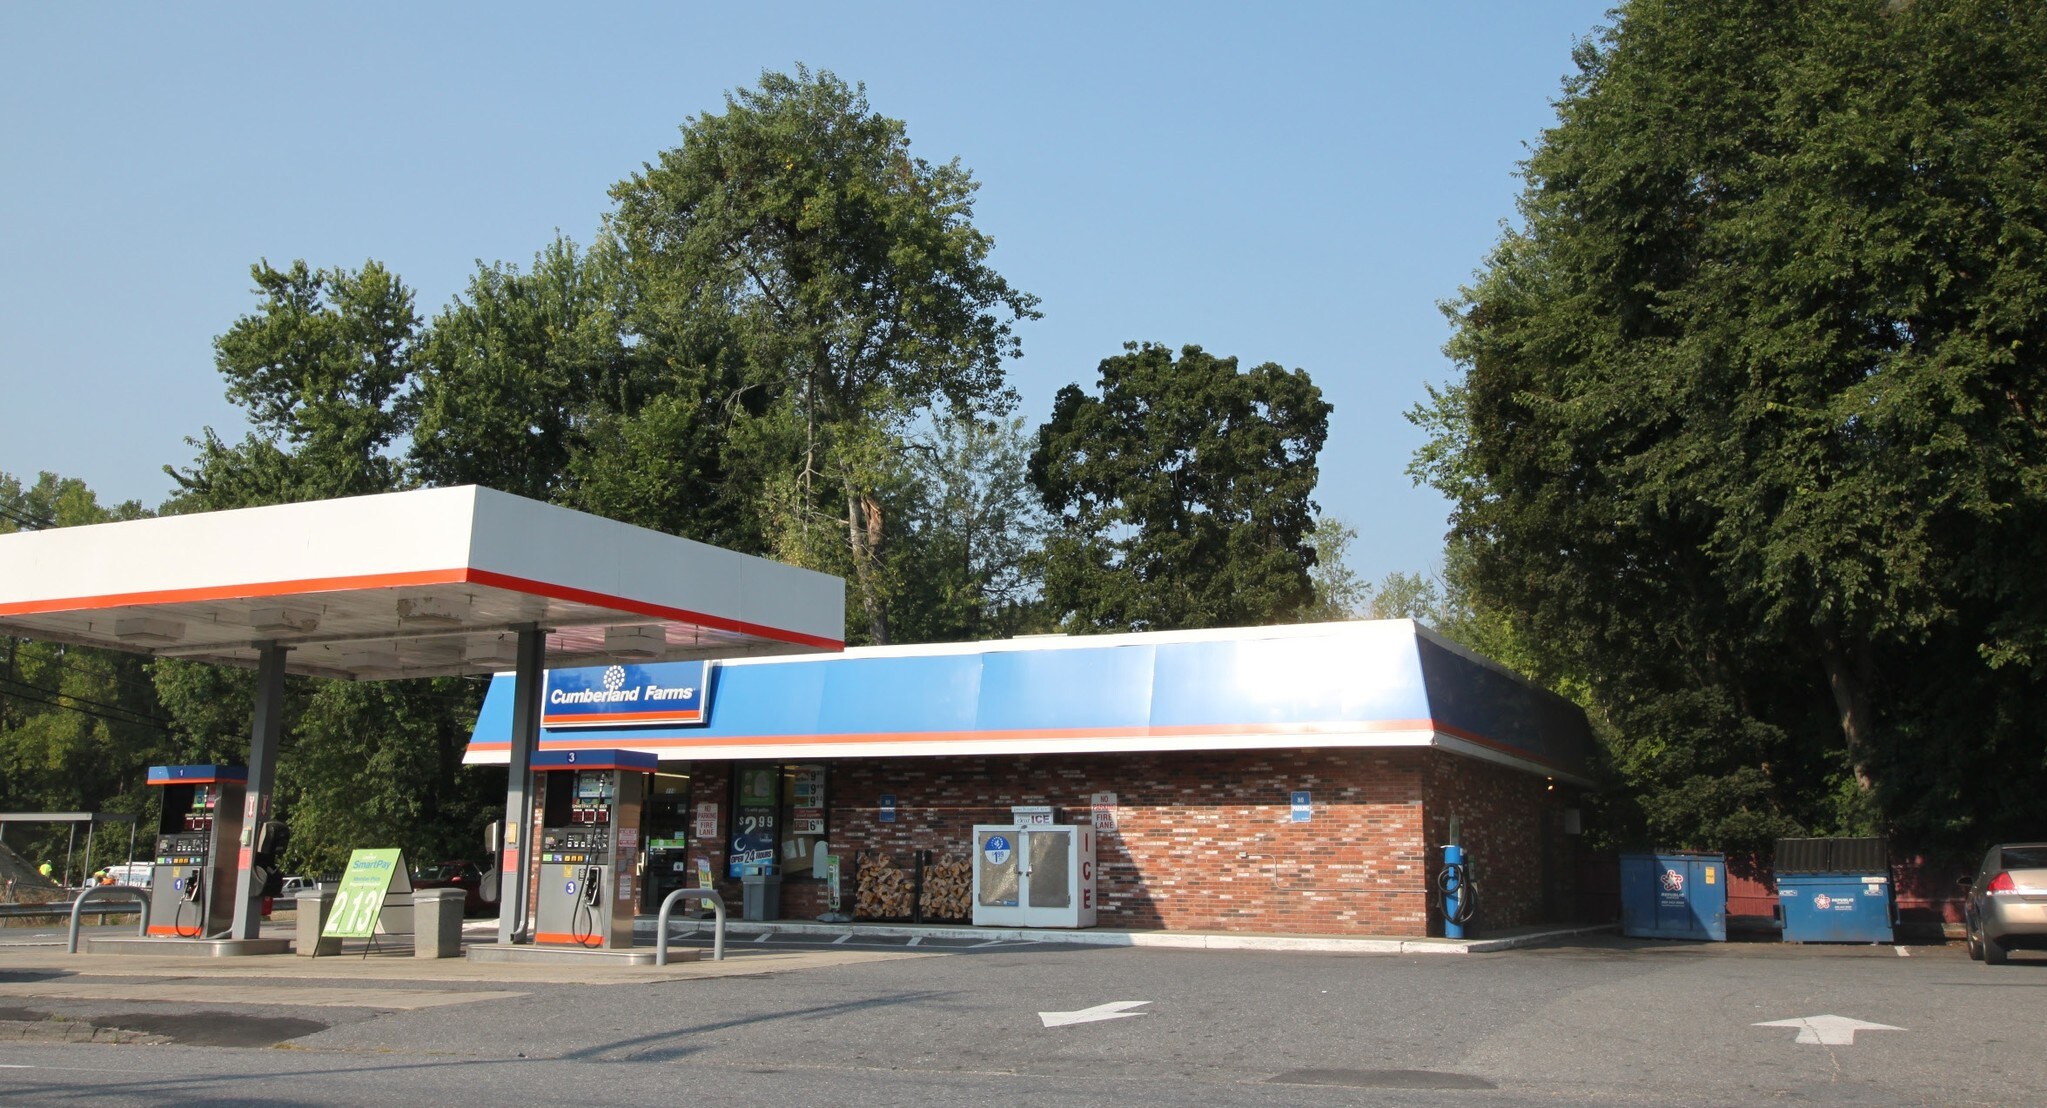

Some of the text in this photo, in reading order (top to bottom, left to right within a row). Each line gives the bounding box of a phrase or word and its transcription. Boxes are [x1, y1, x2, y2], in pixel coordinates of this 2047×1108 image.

[550, 685, 694, 704] Cumberland Farms
[568, 752, 575, 762] 3
[1100, 795, 1109, 803] NO
[1092, 803, 1116, 811] PARKING
[1031, 814, 1050, 824] ICE
[730, 850, 772, 864] OPEN 24 HOURS
[353, 859, 392, 871] SmartPay
[176, 880, 181, 890] 1
[567, 882, 575, 893] 3
